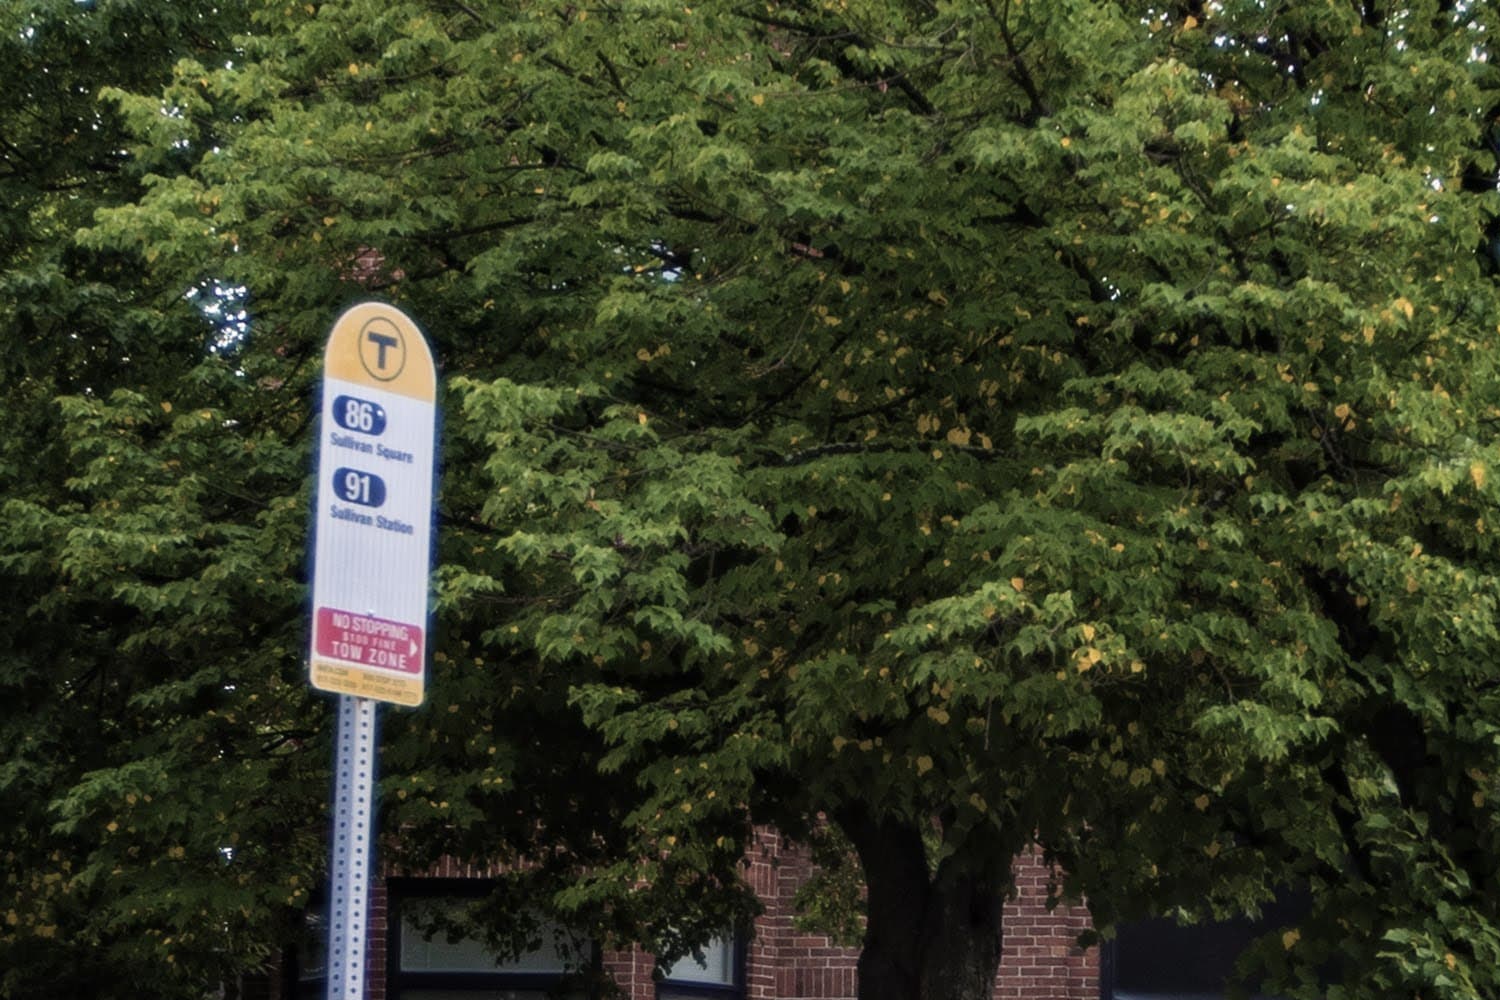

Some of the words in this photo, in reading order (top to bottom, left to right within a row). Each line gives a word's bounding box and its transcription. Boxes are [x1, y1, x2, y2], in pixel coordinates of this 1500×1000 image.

[367, 331, 398, 370] T
[345, 400, 373, 431] 86
[330, 432, 373, 454] Sullivan
[376, 443, 414, 463] Square
[345, 472, 370, 503] 91
[330, 504, 373, 525] Sullivan
[376, 515, 414, 534] Station
[332, 613, 350, 629] NO
[352, 618, 409, 641] STOPPING
[331, 641, 362, 660] TOW
[369, 648, 407, 669] ZONE
[373, 637, 396, 650] FINE
